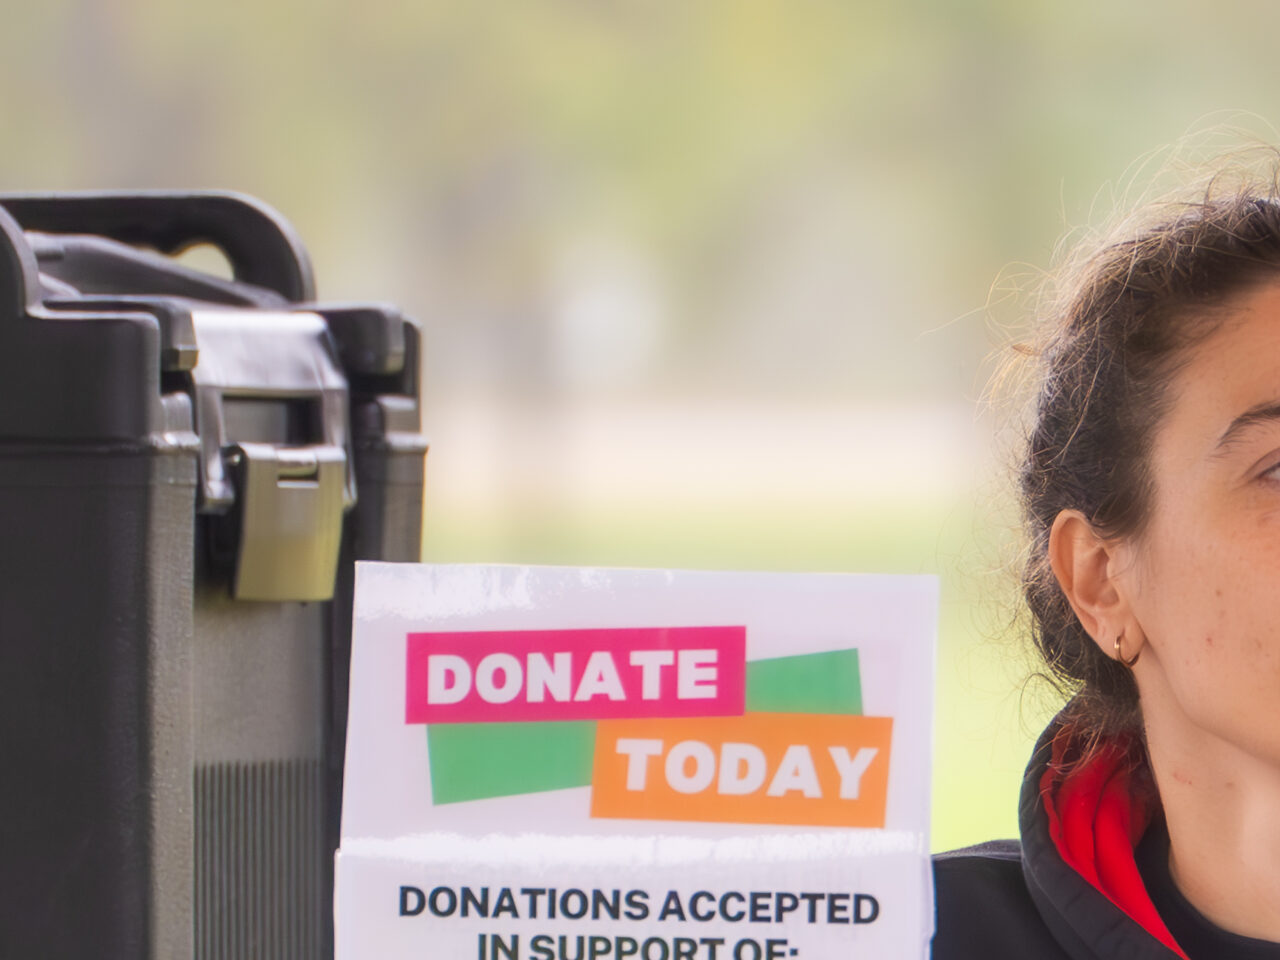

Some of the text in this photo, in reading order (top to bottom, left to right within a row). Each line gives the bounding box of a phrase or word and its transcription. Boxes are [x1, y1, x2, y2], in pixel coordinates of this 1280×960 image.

[426, 648, 718, 705] DONATE
[615, 738, 879, 800] TODAY
[399, 885, 880, 924] DONATIONS ACCEPTED
